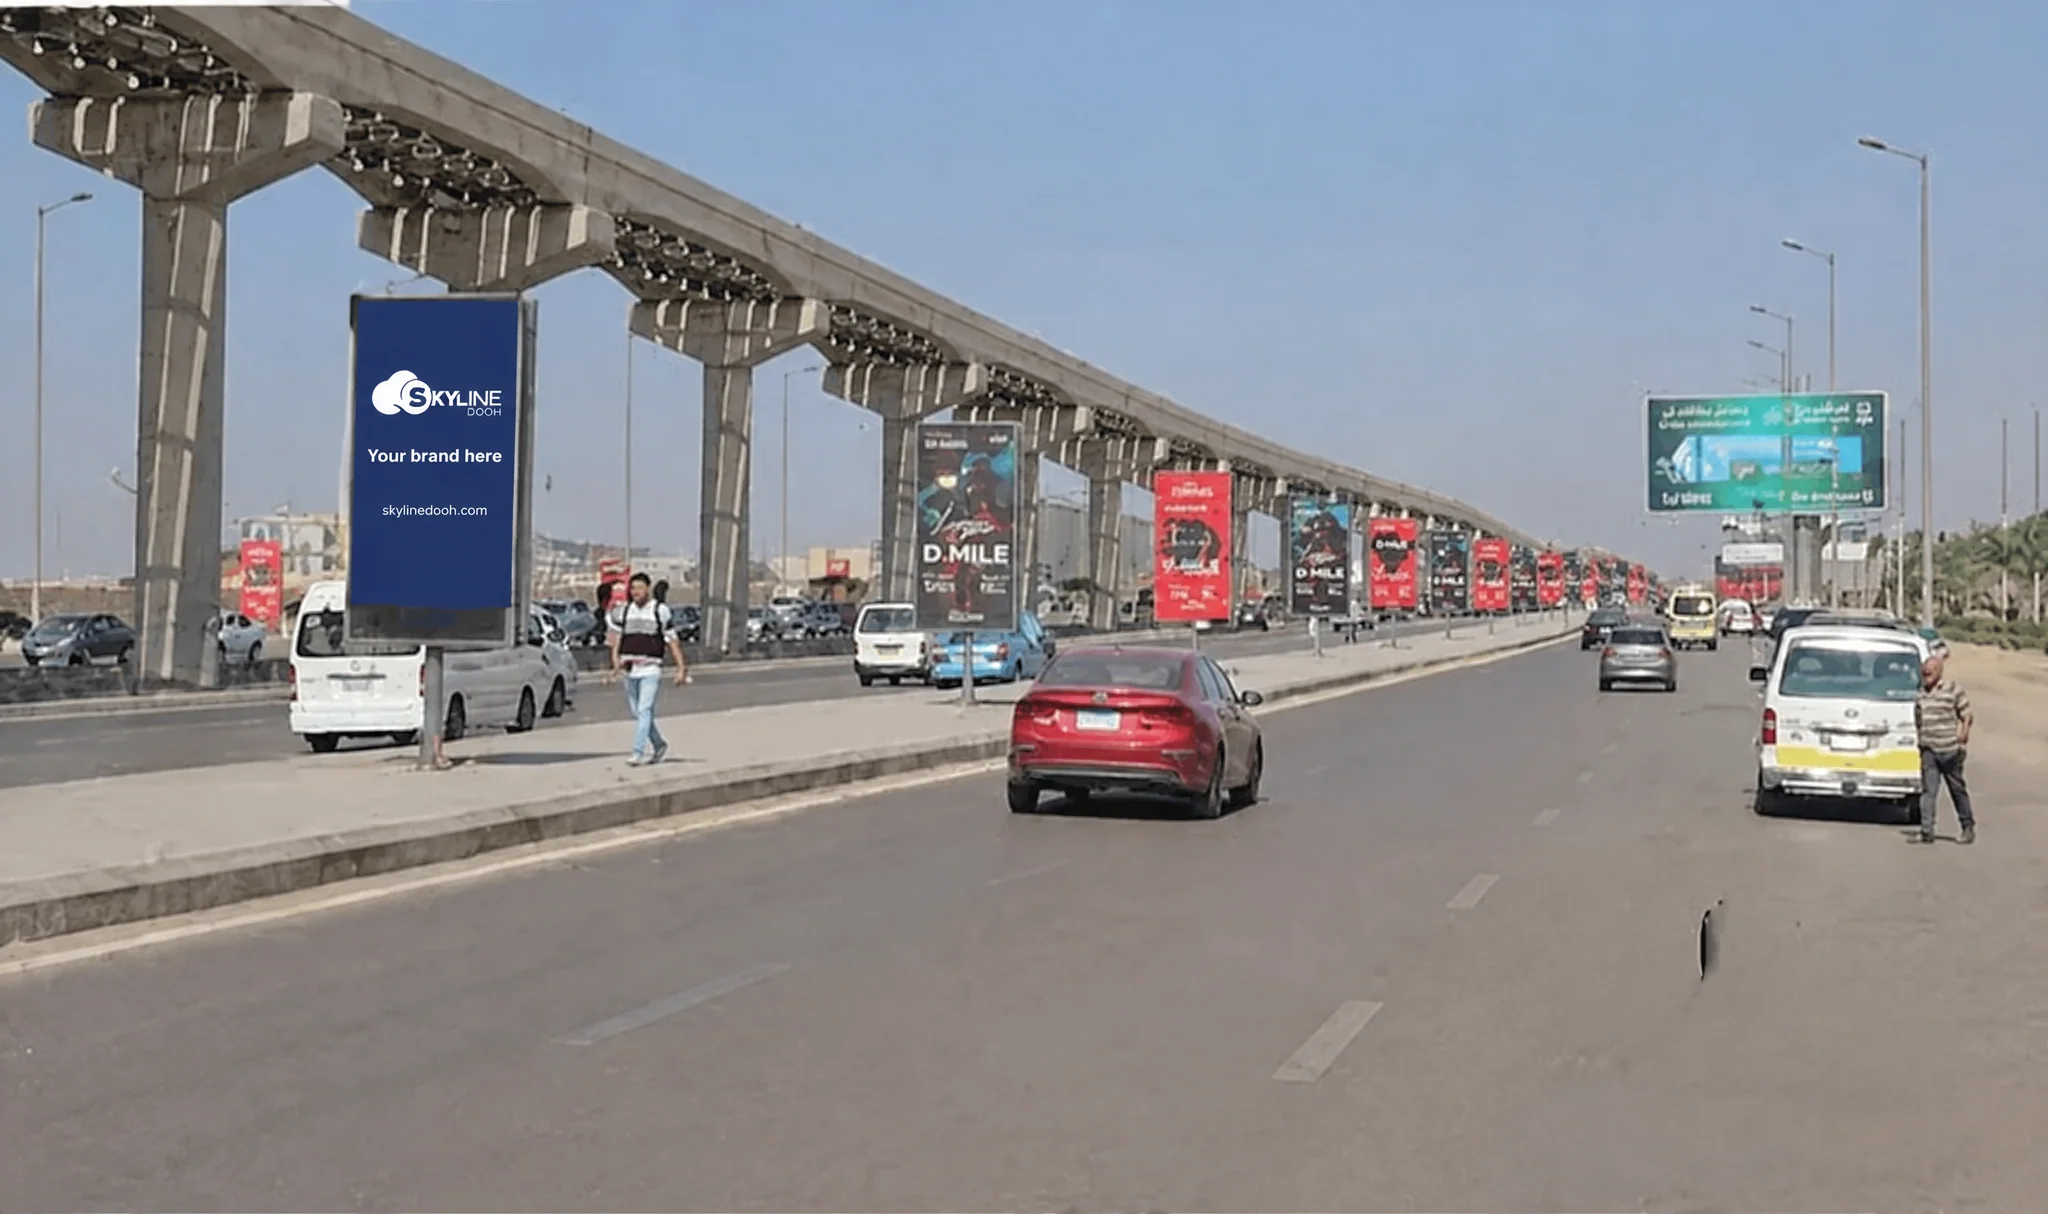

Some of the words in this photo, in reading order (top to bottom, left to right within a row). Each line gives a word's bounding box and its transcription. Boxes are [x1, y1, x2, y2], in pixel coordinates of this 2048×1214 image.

[409, 387, 502, 407] SKYLINE
[467, 407, 502, 416] DOOH
[368, 449, 406, 462] Your
[411, 449, 460, 462] brand
[465, 449, 502, 462] here
[382, 505, 488, 518] skylinedooh.com
[923, 544, 1010, 564] D.MILE
